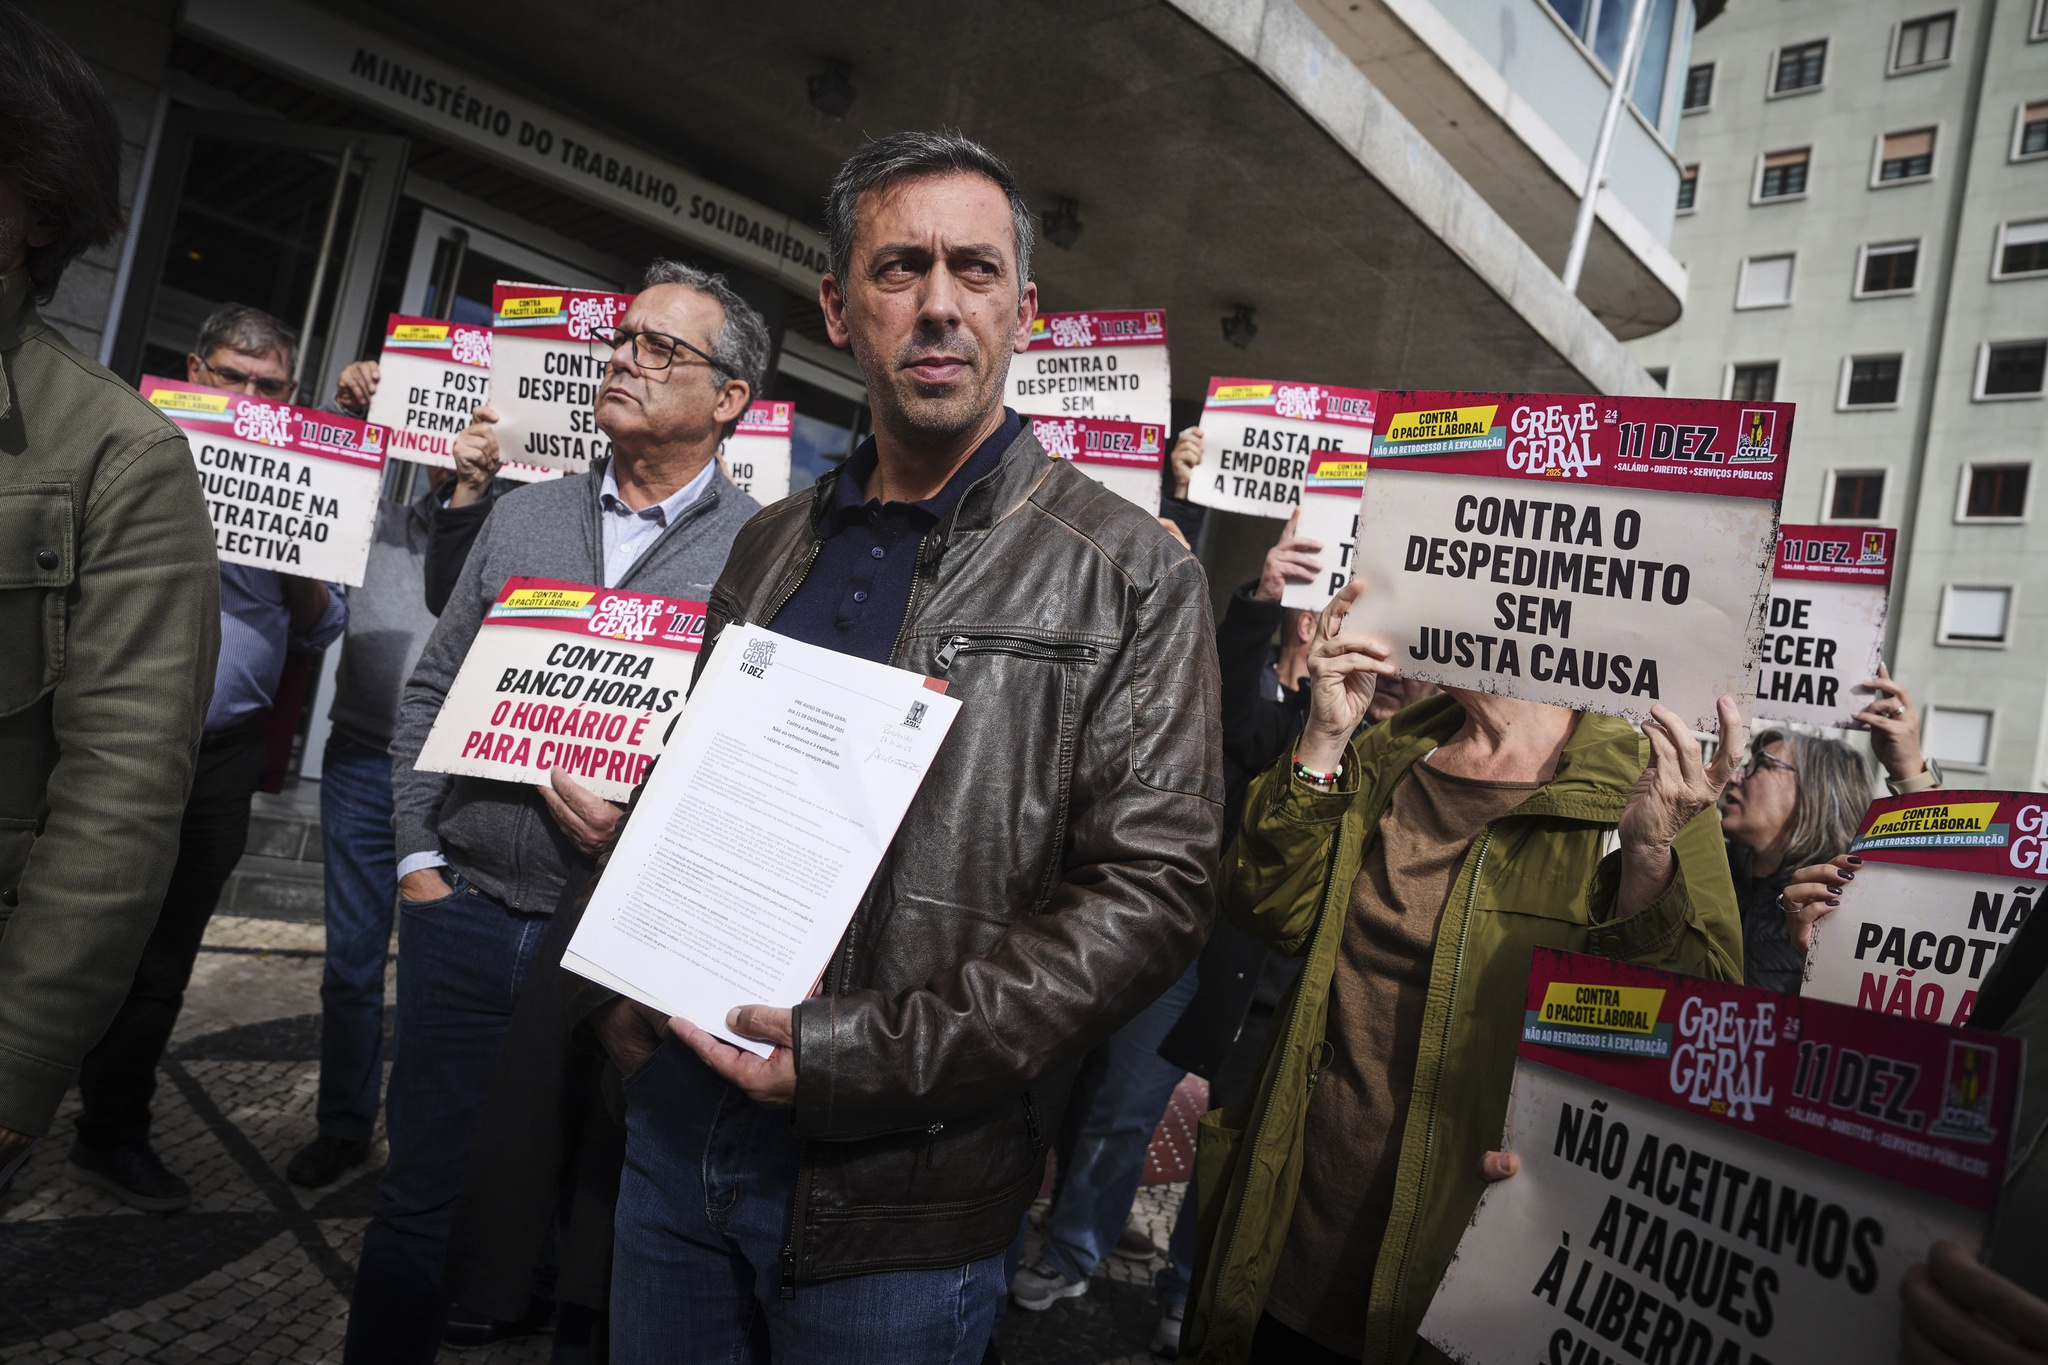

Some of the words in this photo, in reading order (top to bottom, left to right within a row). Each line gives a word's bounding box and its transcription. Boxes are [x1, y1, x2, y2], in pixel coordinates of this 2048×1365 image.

[351, 48, 511, 138] MINISTÉRIO
[518, 121, 553, 155] DO
[562, 138, 682, 215] TRABALHO,
[569, 297, 617, 322] GREVE
[1050, 315, 1092, 333] GREVE
[1038, 356, 1102, 374] CONTRA
[1108, 355, 1117, 371] O
[443, 371, 488, 394] POST
[518, 376, 601, 406] DESPEDI
[1018, 374, 1140, 396] DESPEDIMENTO
[1278, 386, 1320, 402] GREVE
[409, 387, 430, 406] DE
[1062, 396, 1094, 412] SEM
[1275, 399, 1321, 420] GERAL
[1326, 396, 1340, 412] 11
[1342, 398, 1372, 416] DEZ.
[236, 400, 292, 424] GREVE
[1419, 410, 1458, 425] CONTRA
[1510, 402, 1598, 441] GREVE
[1604, 410, 1618, 419] 24
[234, 420, 294, 447] GERAL
[301, 421, 316, 442] 11
[320, 425, 358, 450] DEZ.
[1086, 432, 1098, 448] 11
[1102, 433, 1136, 453] DEZ.
[1242, 427, 1310, 455] BASTA
[1392, 428, 1399, 439] O
[1400, 426, 1437, 438] PACOTE
[1438, 421, 1484, 436] LABORAL
[1618, 422, 1646, 458] 11
[1650, 423, 1725, 463] DEZ.
[525, 432, 585, 460] JUSTA
[1373, 446, 1388, 456] NÃO
[1388, 446, 1398, 455] AO
[1399, 443, 1442, 454] RETROCESSO
[1442, 442, 1448, 451] E
[1448, 438, 1454, 450] À
[1454, 438, 1502, 450] EXPLORAÇÃO
[1506, 433, 1600, 478] GERAL
[1738, 446, 1768, 457] CGTP
[200, 445, 290, 482] CONTRA
[297, 466, 311, 487] A
[1220, 450, 1306, 480] EMPOBR
[1546, 468, 1562, 477] 2025
[1732, 467, 1774, 480] PÚBLICOS
[1215, 474, 1225, 494] A
[1233, 476, 1301, 506] TRABA
[309, 494, 338, 519] NA
[1454, 494, 1602, 547] CONTRA
[1613, 508, 1641, 550] O
[1784, 540, 1802, 562] 11
[1806, 541, 1854, 564] DEZ.
[1404, 535, 1690, 606] DESPEDIMENTO
[545, 599, 580, 608] LABORAL
[600, 596, 664, 620] GREVE
[1494, 592, 1572, 639] SEM
[1769, 597, 1812, 630] DE
[588, 612, 657, 641] GERAL
[667, 612, 694, 634] 11
[743, 648, 774, 669] GERAL
[748, 637, 778, 654] GREVE
[546, 643, 654, 679] CONTRA
[739, 662, 747, 672] 11
[747, 664, 764, 680] DEZ.
[1408, 626, 1520, 677] JUSTA
[1530, 644, 1660, 700] CAUSA
[496, 668, 586, 699] BANCO
[582, 678, 678, 713] HORAS
[490, 700, 512, 726] O
[509, 702, 628, 742] HORÁRIO
[627, 712, 653, 746] É
[786, 720, 801, 728] Contra
[805, 727, 819, 735] Pacote
[462, 731, 538, 766] PARA
[787, 732, 809, 744] retrocesso
[766, 736, 781, 745] salário
[785, 744, 802, 754] direitos
[805, 752, 822, 762] serviços
[822, 759, 840, 769] públicos
[1902, 806, 1949, 820] CONTRA
[1871, 826, 1879, 835] O
[1880, 820, 1922, 834] PACOTE
[1923, 818, 1982, 830] LABORAL
[1863, 840, 1874, 848] AO
[1874, 836, 1927, 846] RETROCESSO
[1928, 836, 1934, 844] E
[1935, 833, 1942, 844] À
[1943, 833, 2004, 846] EXPLORAÇÃO
[1854, 922, 2008, 979] PACOT
[1576, 986, 1620, 1007] CONTRA
[1857, 967, 1945, 1024] NÃO
[1546, 1002, 1554, 1020] O
[1554, 1004, 1596, 1025] PACOTE
[1597, 1007, 1649, 1030] LABORAL
[1679, 996, 1776, 1062] GREVE
[1524, 1025, 1541, 1040] NÃO
[1542, 1030, 1552, 1042] AO
[1552, 1031, 1600, 1048] RETROCESSO
[1600, 1034, 1607, 1047] E
[1608, 1032, 1614, 1049] À
[1614, 1036, 1668, 1056] EXPLORAÇÃO
[1670, 1043, 1774, 1122] GERAL
[1792, 1040, 1832, 1103] 11
[1828, 1047, 1926, 1133] DEZ.
[1553, 1098, 1630, 1181] NÃO
[1627, 1133, 1885, 1296] ACEITAMOS
[1532, 1230, 1571, 1307] À
[1588, 1194, 1780, 1338] ATAQUES
